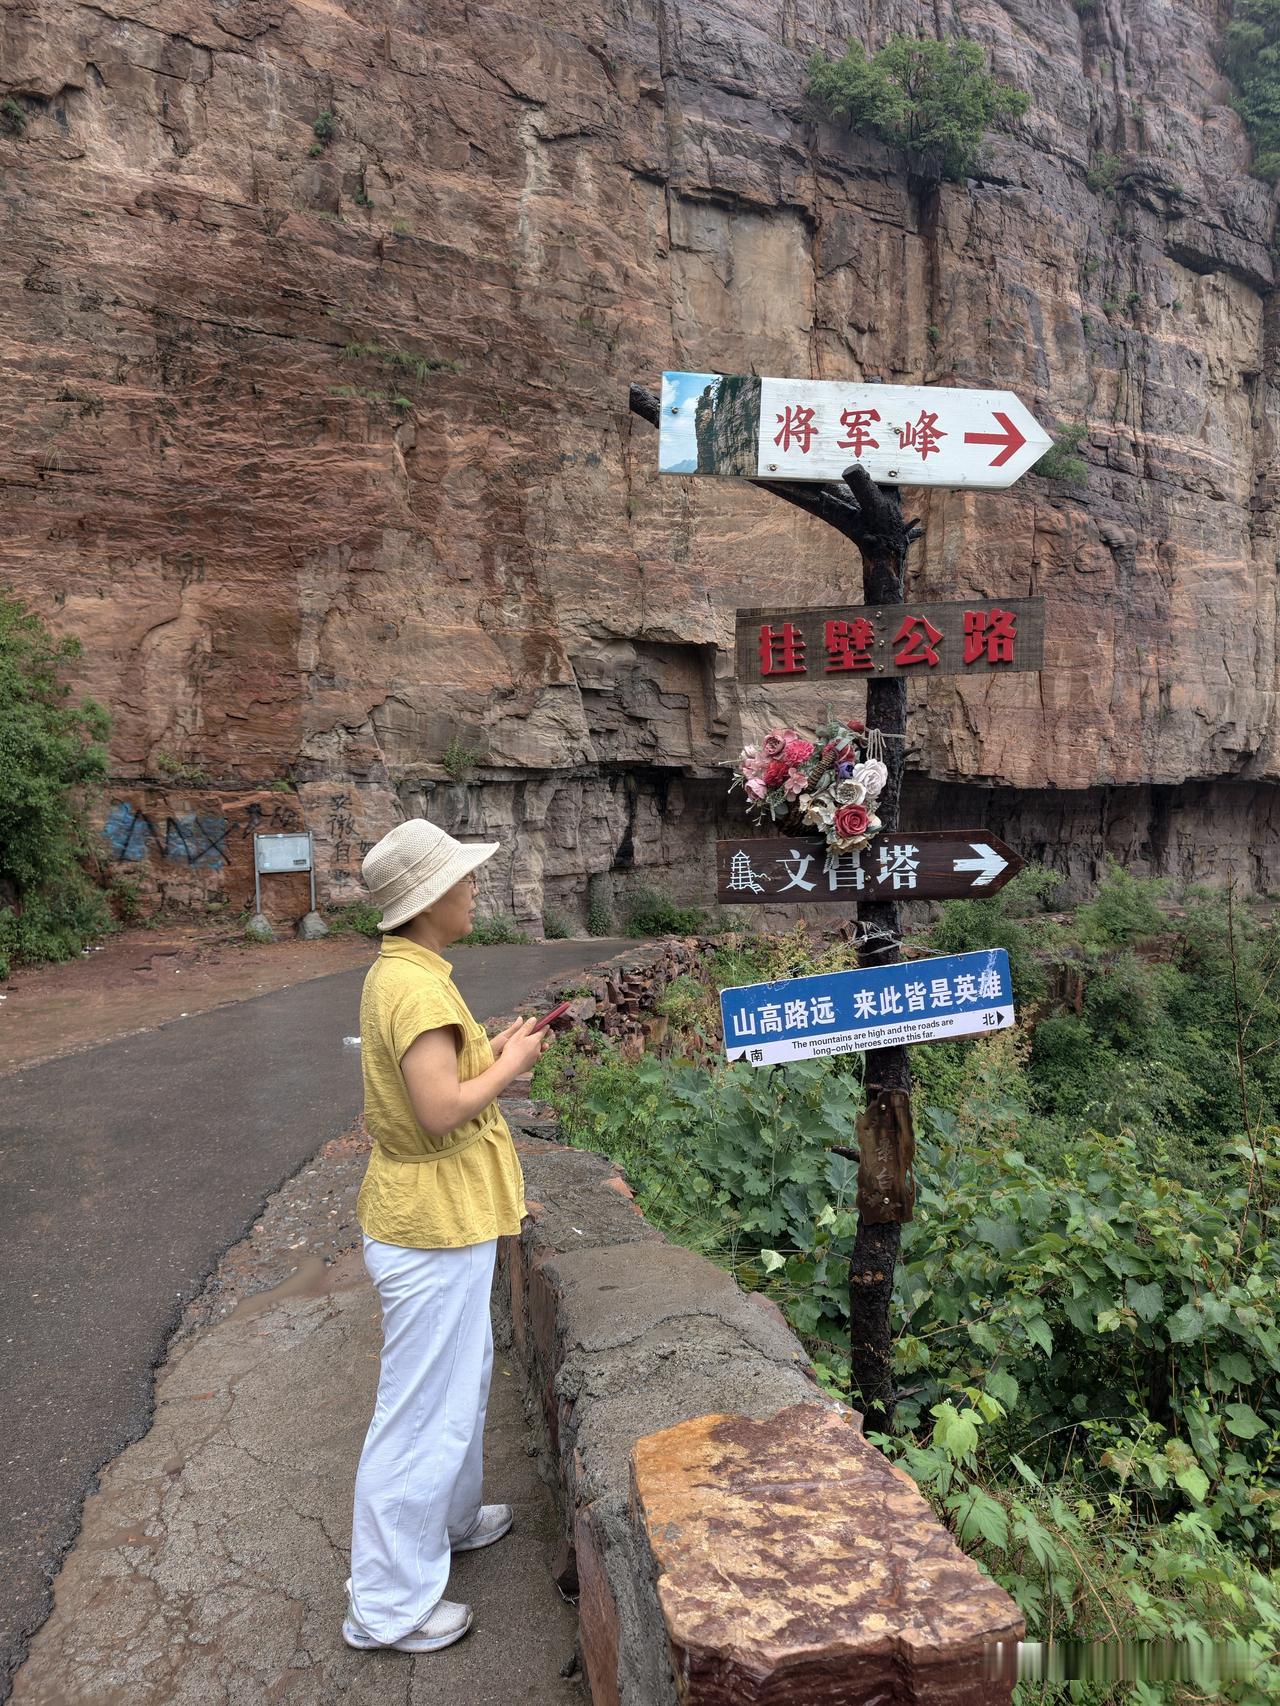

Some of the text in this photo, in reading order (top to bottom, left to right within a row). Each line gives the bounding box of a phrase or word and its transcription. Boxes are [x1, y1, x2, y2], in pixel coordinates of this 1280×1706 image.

[773, 405, 948, 461] 将军峰
[759, 608, 1017, 676] 挂壁公路
[776, 844, 921, 893] 文昌塔
[732, 970, 1003, 1037] 山高路远 来此皆是英雄
[983, 1013, 995, 1026] 北
[792, 1041, 807, 1049] The
[809, 1033, 852, 1047] mountains
[868, 1028, 885, 1040] high
[887, 1025, 902, 1035] and
[903, 1024, 916, 1032] the
[918, 1020, 940, 1031] roads
[854, 1039, 881, 1050] heroes
[883, 1036, 905, 1045] come
[906, 1031, 921, 1042] this
[922, 1030, 935, 1039] far.
[750, 1049, 763, 1062] 南
